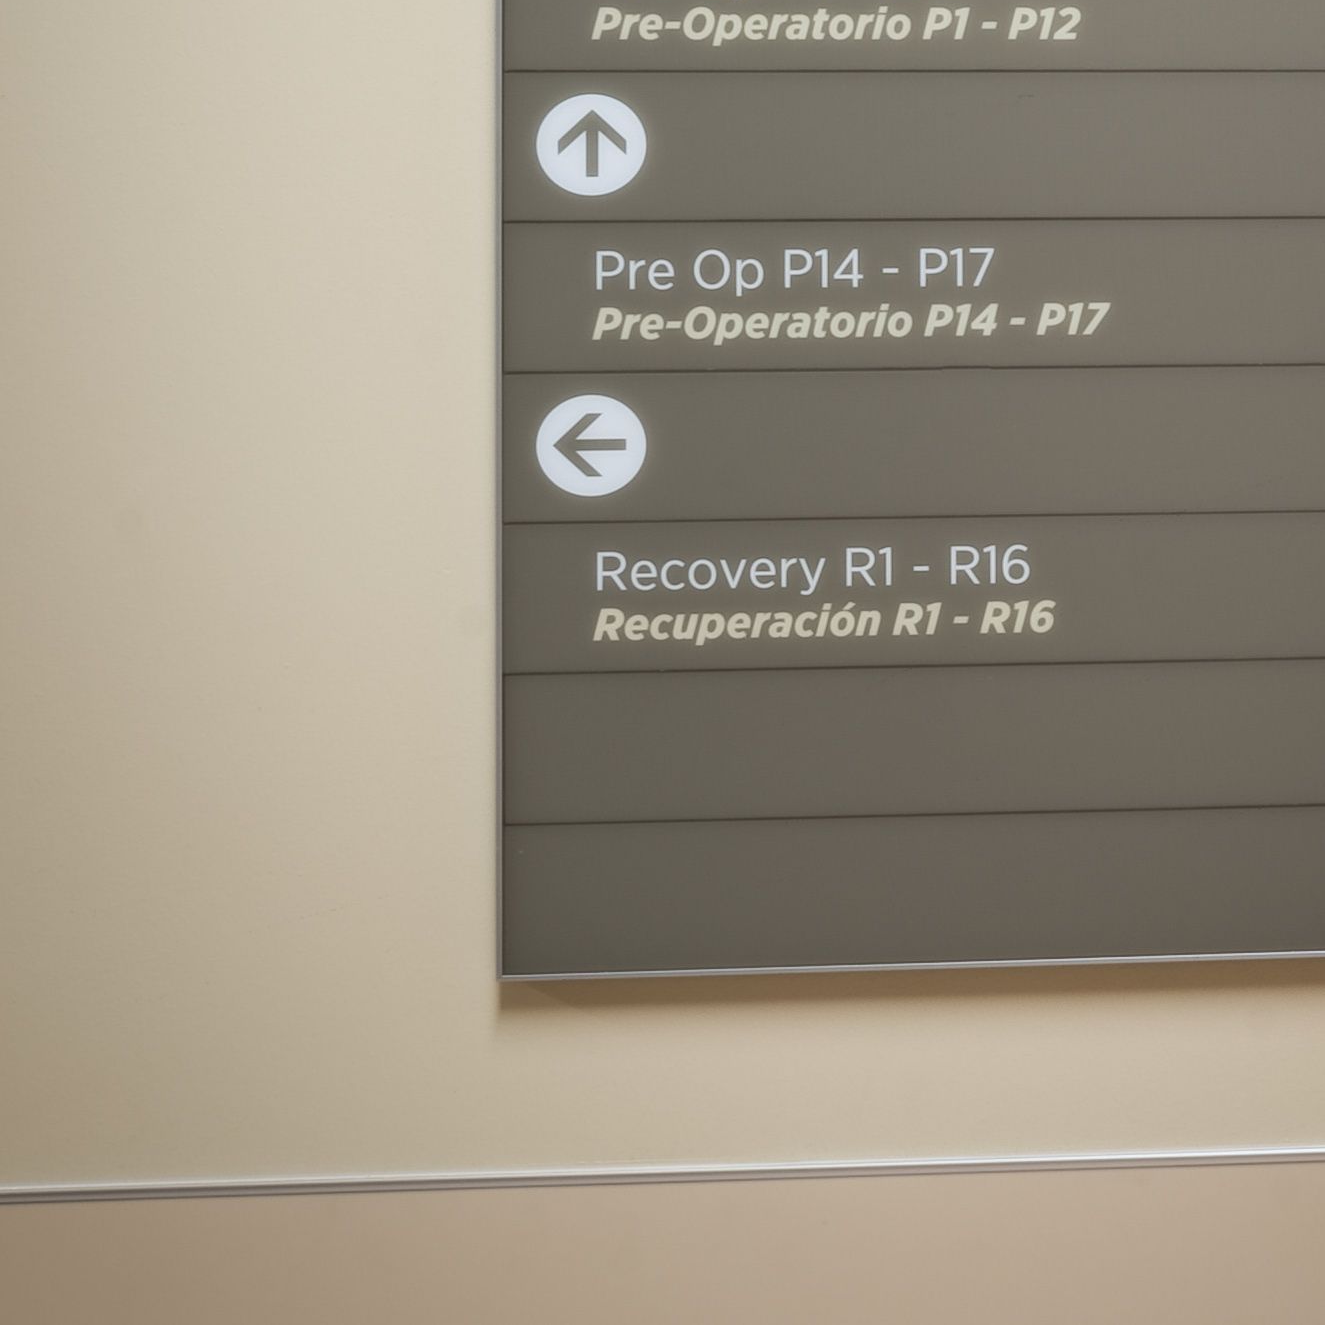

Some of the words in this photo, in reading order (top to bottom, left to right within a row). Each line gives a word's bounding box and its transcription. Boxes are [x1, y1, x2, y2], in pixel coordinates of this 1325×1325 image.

[592, 5, 913, 48] Pre-Operatorio
[923, 7, 972, 41] P1
[982, 22, 999, 31] -
[1008, 7, 1083, 42] P12
[596, 251, 676, 292] Pre
[694, 250, 766, 296] Op
[784, 249, 865, 290] P14
[920, 248, 996, 289] P17
[593, 304, 914, 347] Pre-Operatorio
[924, 302, 1000, 338] P14
[1010, 317, 1027, 327] -
[1037, 302, 1113, 337] P17
[597, 552, 827, 597] Recovery
[846, 547, 894, 588] R1
[951, 545, 1032, 586] R16
[593, 602, 883, 647] Recuperación
[893, 602, 943, 637] R1
[953, 616, 971, 625] -
[980, 600, 1058, 635] R16
